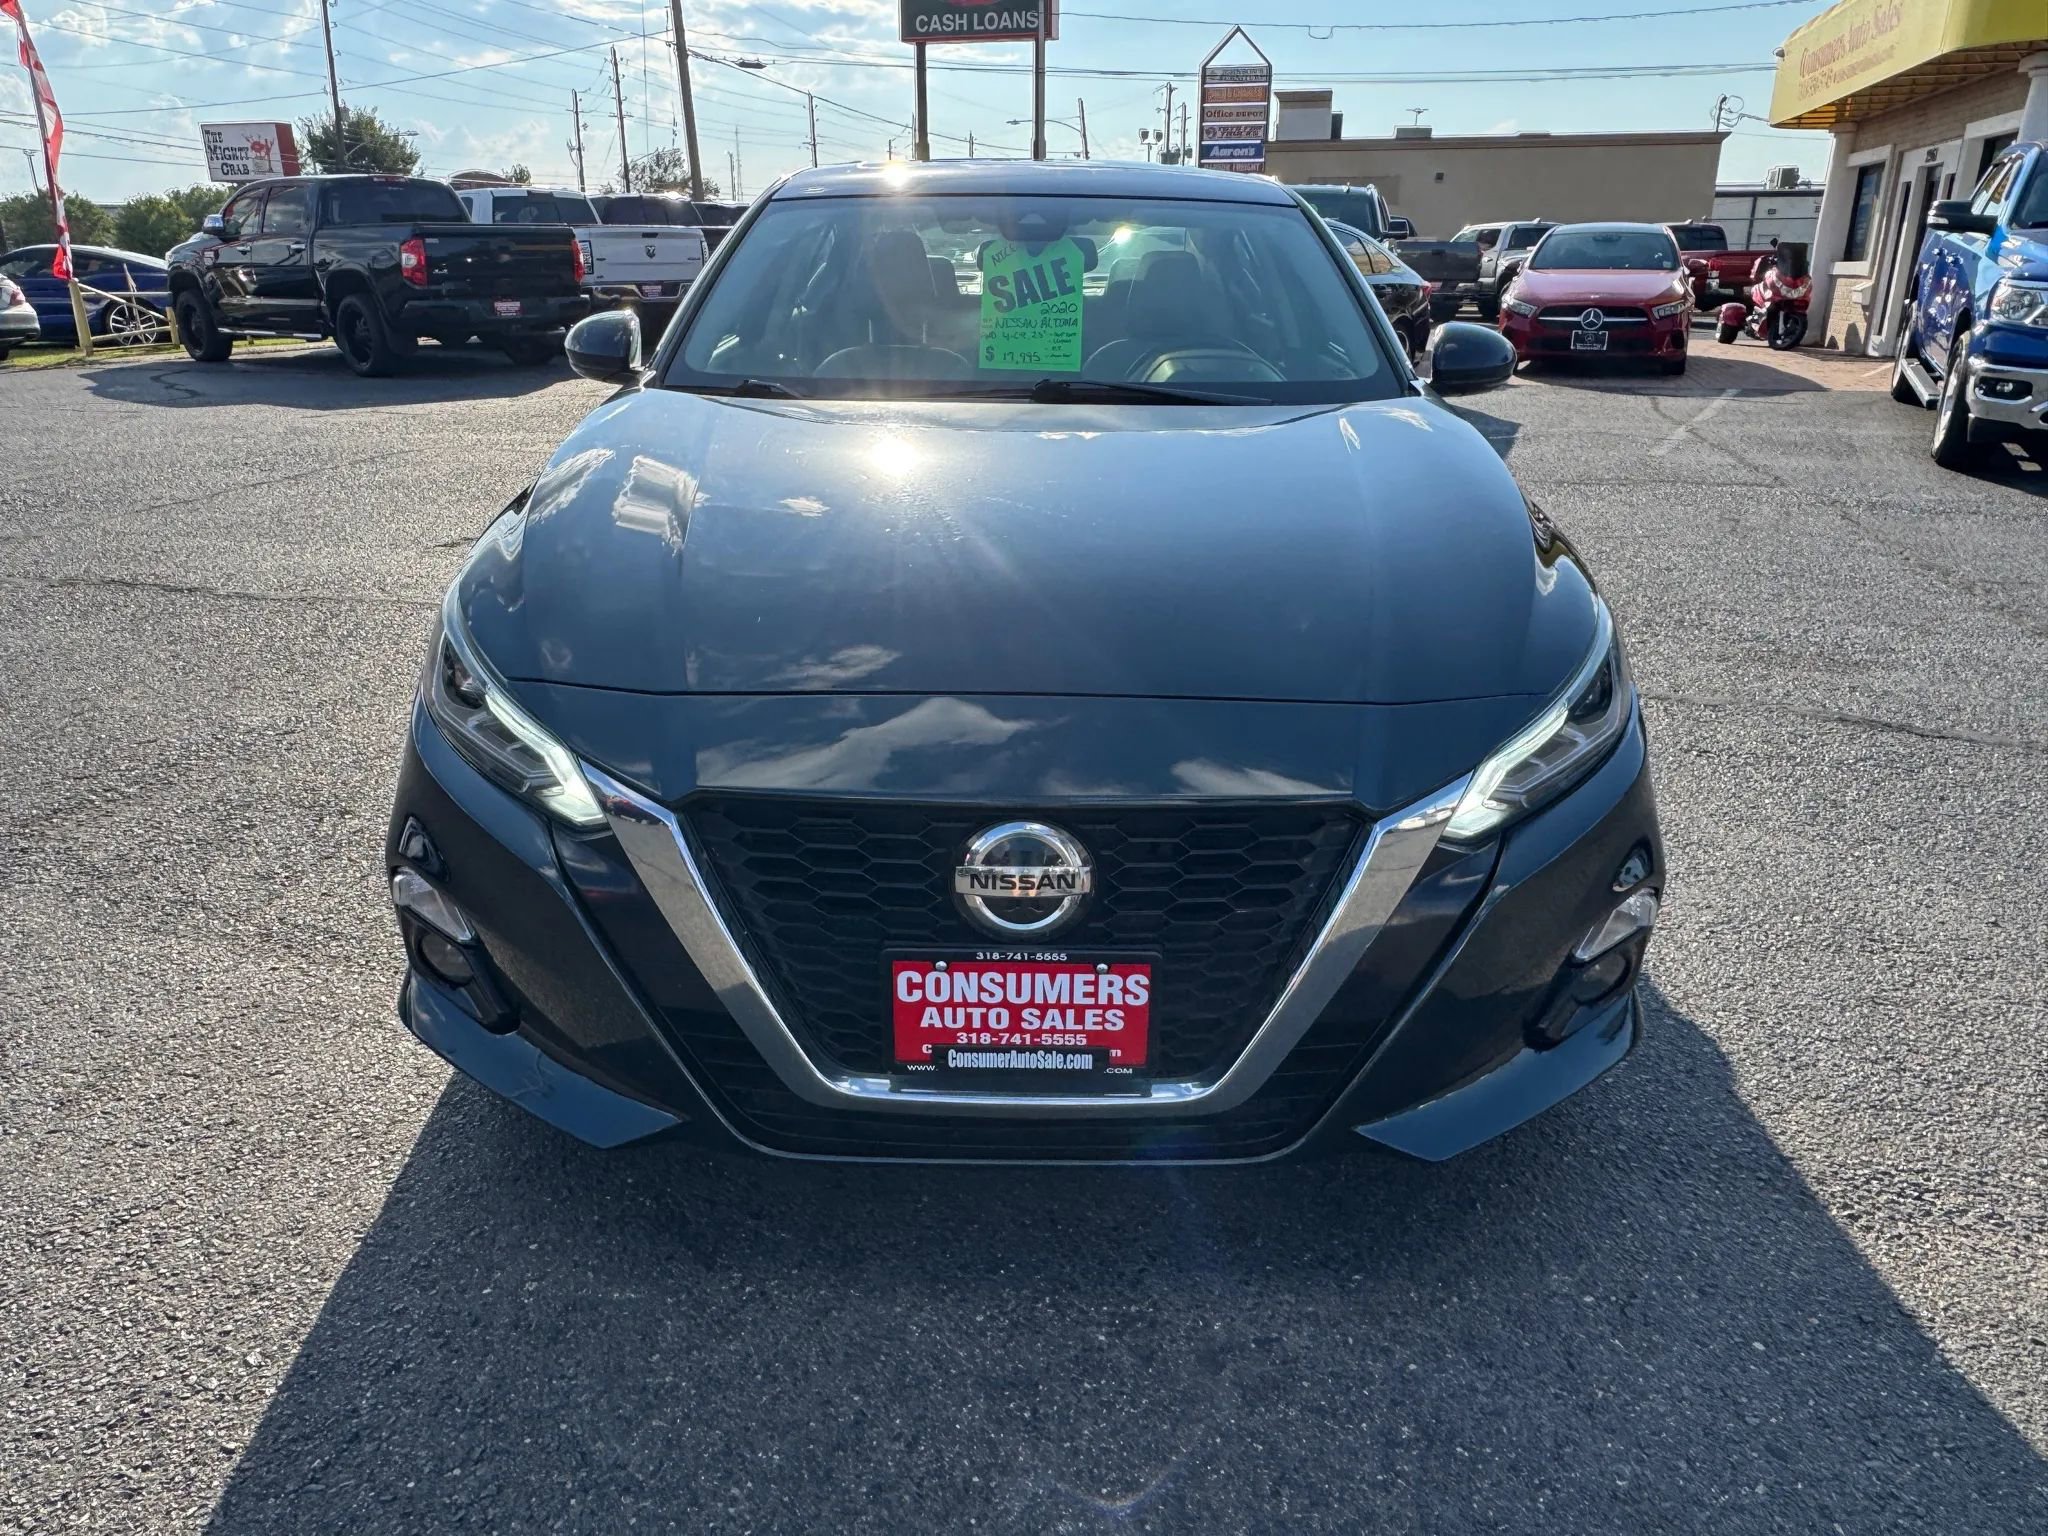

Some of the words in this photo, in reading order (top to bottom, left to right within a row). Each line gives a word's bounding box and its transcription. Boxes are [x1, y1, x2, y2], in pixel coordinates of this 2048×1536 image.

[915, 13, 968, 33] CASH
[973, 10, 1039, 31] LOANS
[1205, 109, 1234, 118] Office
[204, 130, 224, 144] THE
[206, 144, 250, 161] MIGHTY
[1209, 145, 1256, 158] Aaron's
[220, 162, 250, 176] CRAB
[987, 256, 1077, 314] SALE
[1040, 302, 1078, 315] 2020
[985, 345, 996, 362] $
[969, 873, 1076, 891] NISSAN
[975, 951, 1068, 961] 318-741-5555
[896, 971, 1150, 1006] CONSUMERS
[920, 1006, 1010, 1030] AUTO
[1020, 1008, 1125, 1031] SALES
[956, 1032, 1088, 1046] 318-741-5555
[947, 1048, 1093, 1070] ConsumerAutoSale.com
